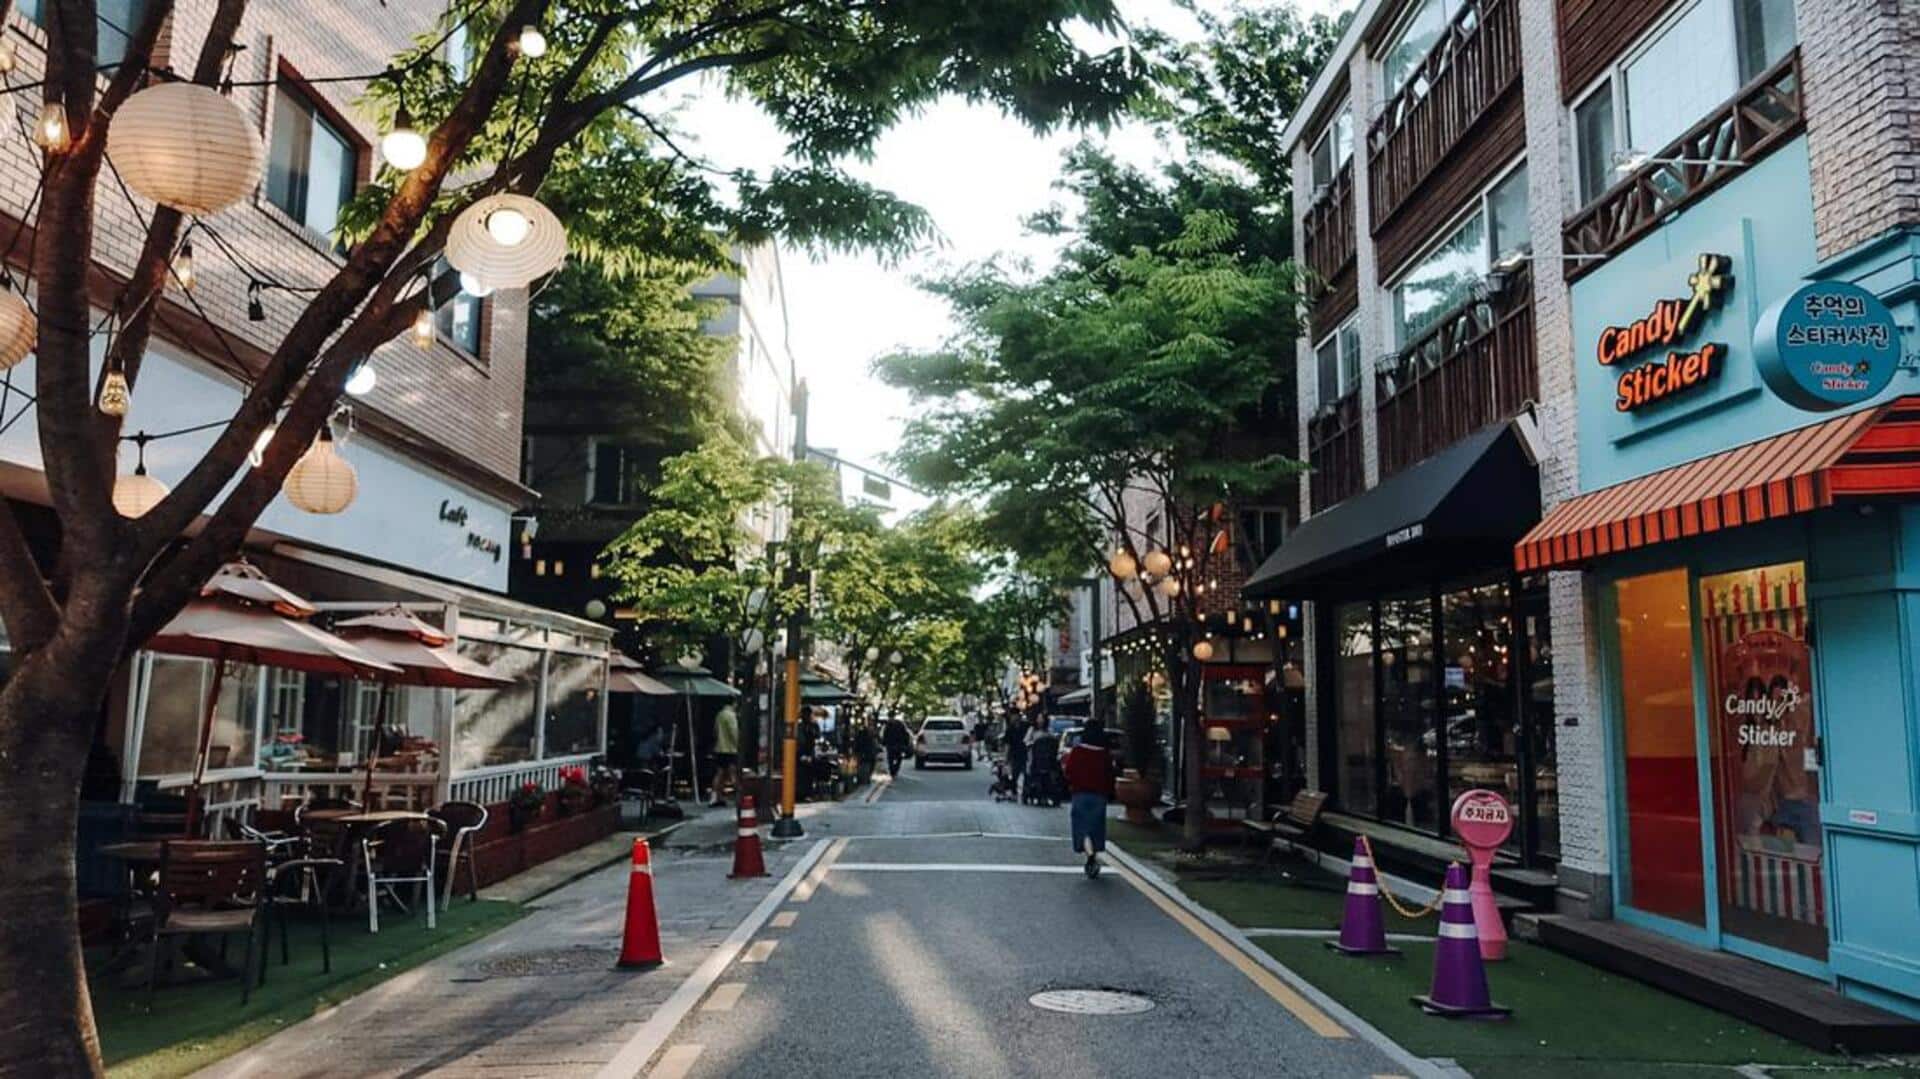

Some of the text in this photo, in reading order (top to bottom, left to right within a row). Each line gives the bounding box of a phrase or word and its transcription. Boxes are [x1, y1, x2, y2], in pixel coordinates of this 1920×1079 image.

[1805, 294, 1865, 319] 추억의
[1598, 299, 1681, 365] Candy
[1787, 323, 1889, 349] 스티커사진
[1617, 343, 1715, 412] Sticker
[1810, 362, 1853, 376] Candy
[1725, 694, 1776, 719] Candy
[1738, 724, 1796, 746] Sticker
